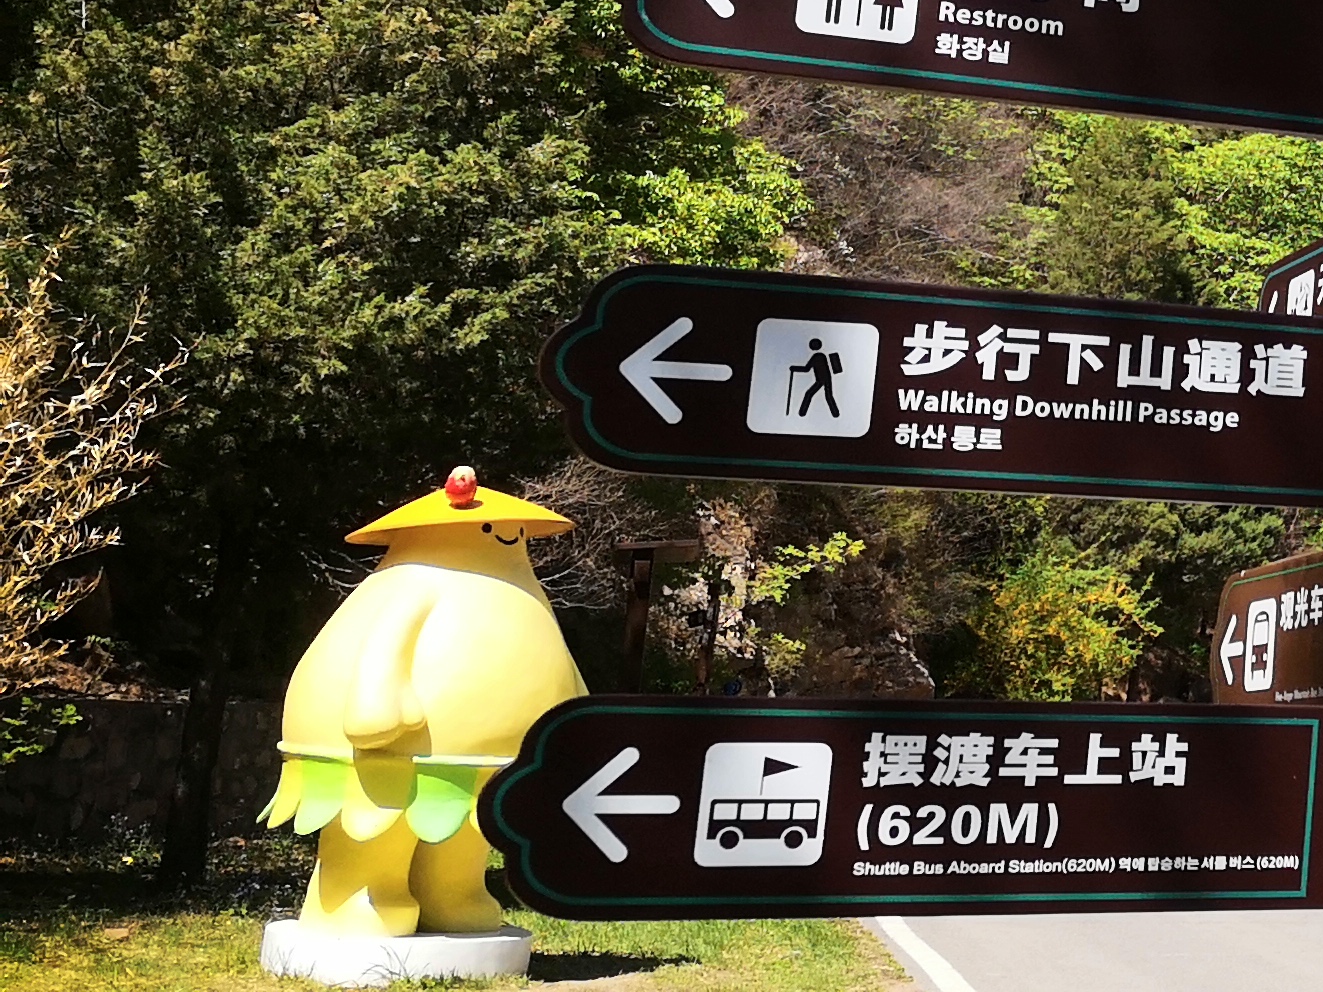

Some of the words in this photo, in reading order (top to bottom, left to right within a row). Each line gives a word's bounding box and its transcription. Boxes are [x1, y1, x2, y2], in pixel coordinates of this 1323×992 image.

[938, 1, 1064, 36] Restroom
[935, 33, 1011, 64] 화장실
[900, 321, 1308, 397] 步行下山通道
[898, 389, 1010, 421] Walking
[1015, 394, 1132, 423] Downhill
[1138, 403, 1240, 432] Passage
[894, 423, 946, 449] 하산
[951, 426, 1003, 451] 통로
[861, 732, 1189, 787] 摆渡车上站
[857, 803, 1059, 850] (620M)
[853, 862, 909, 875] Shuttle
[913, 861, 944, 875] Bus
[947, 860, 1005, 874] Aboard
[1008, 857, 1115, 874] Station(620M)
[1257, 855, 1299, 870] (620M)
